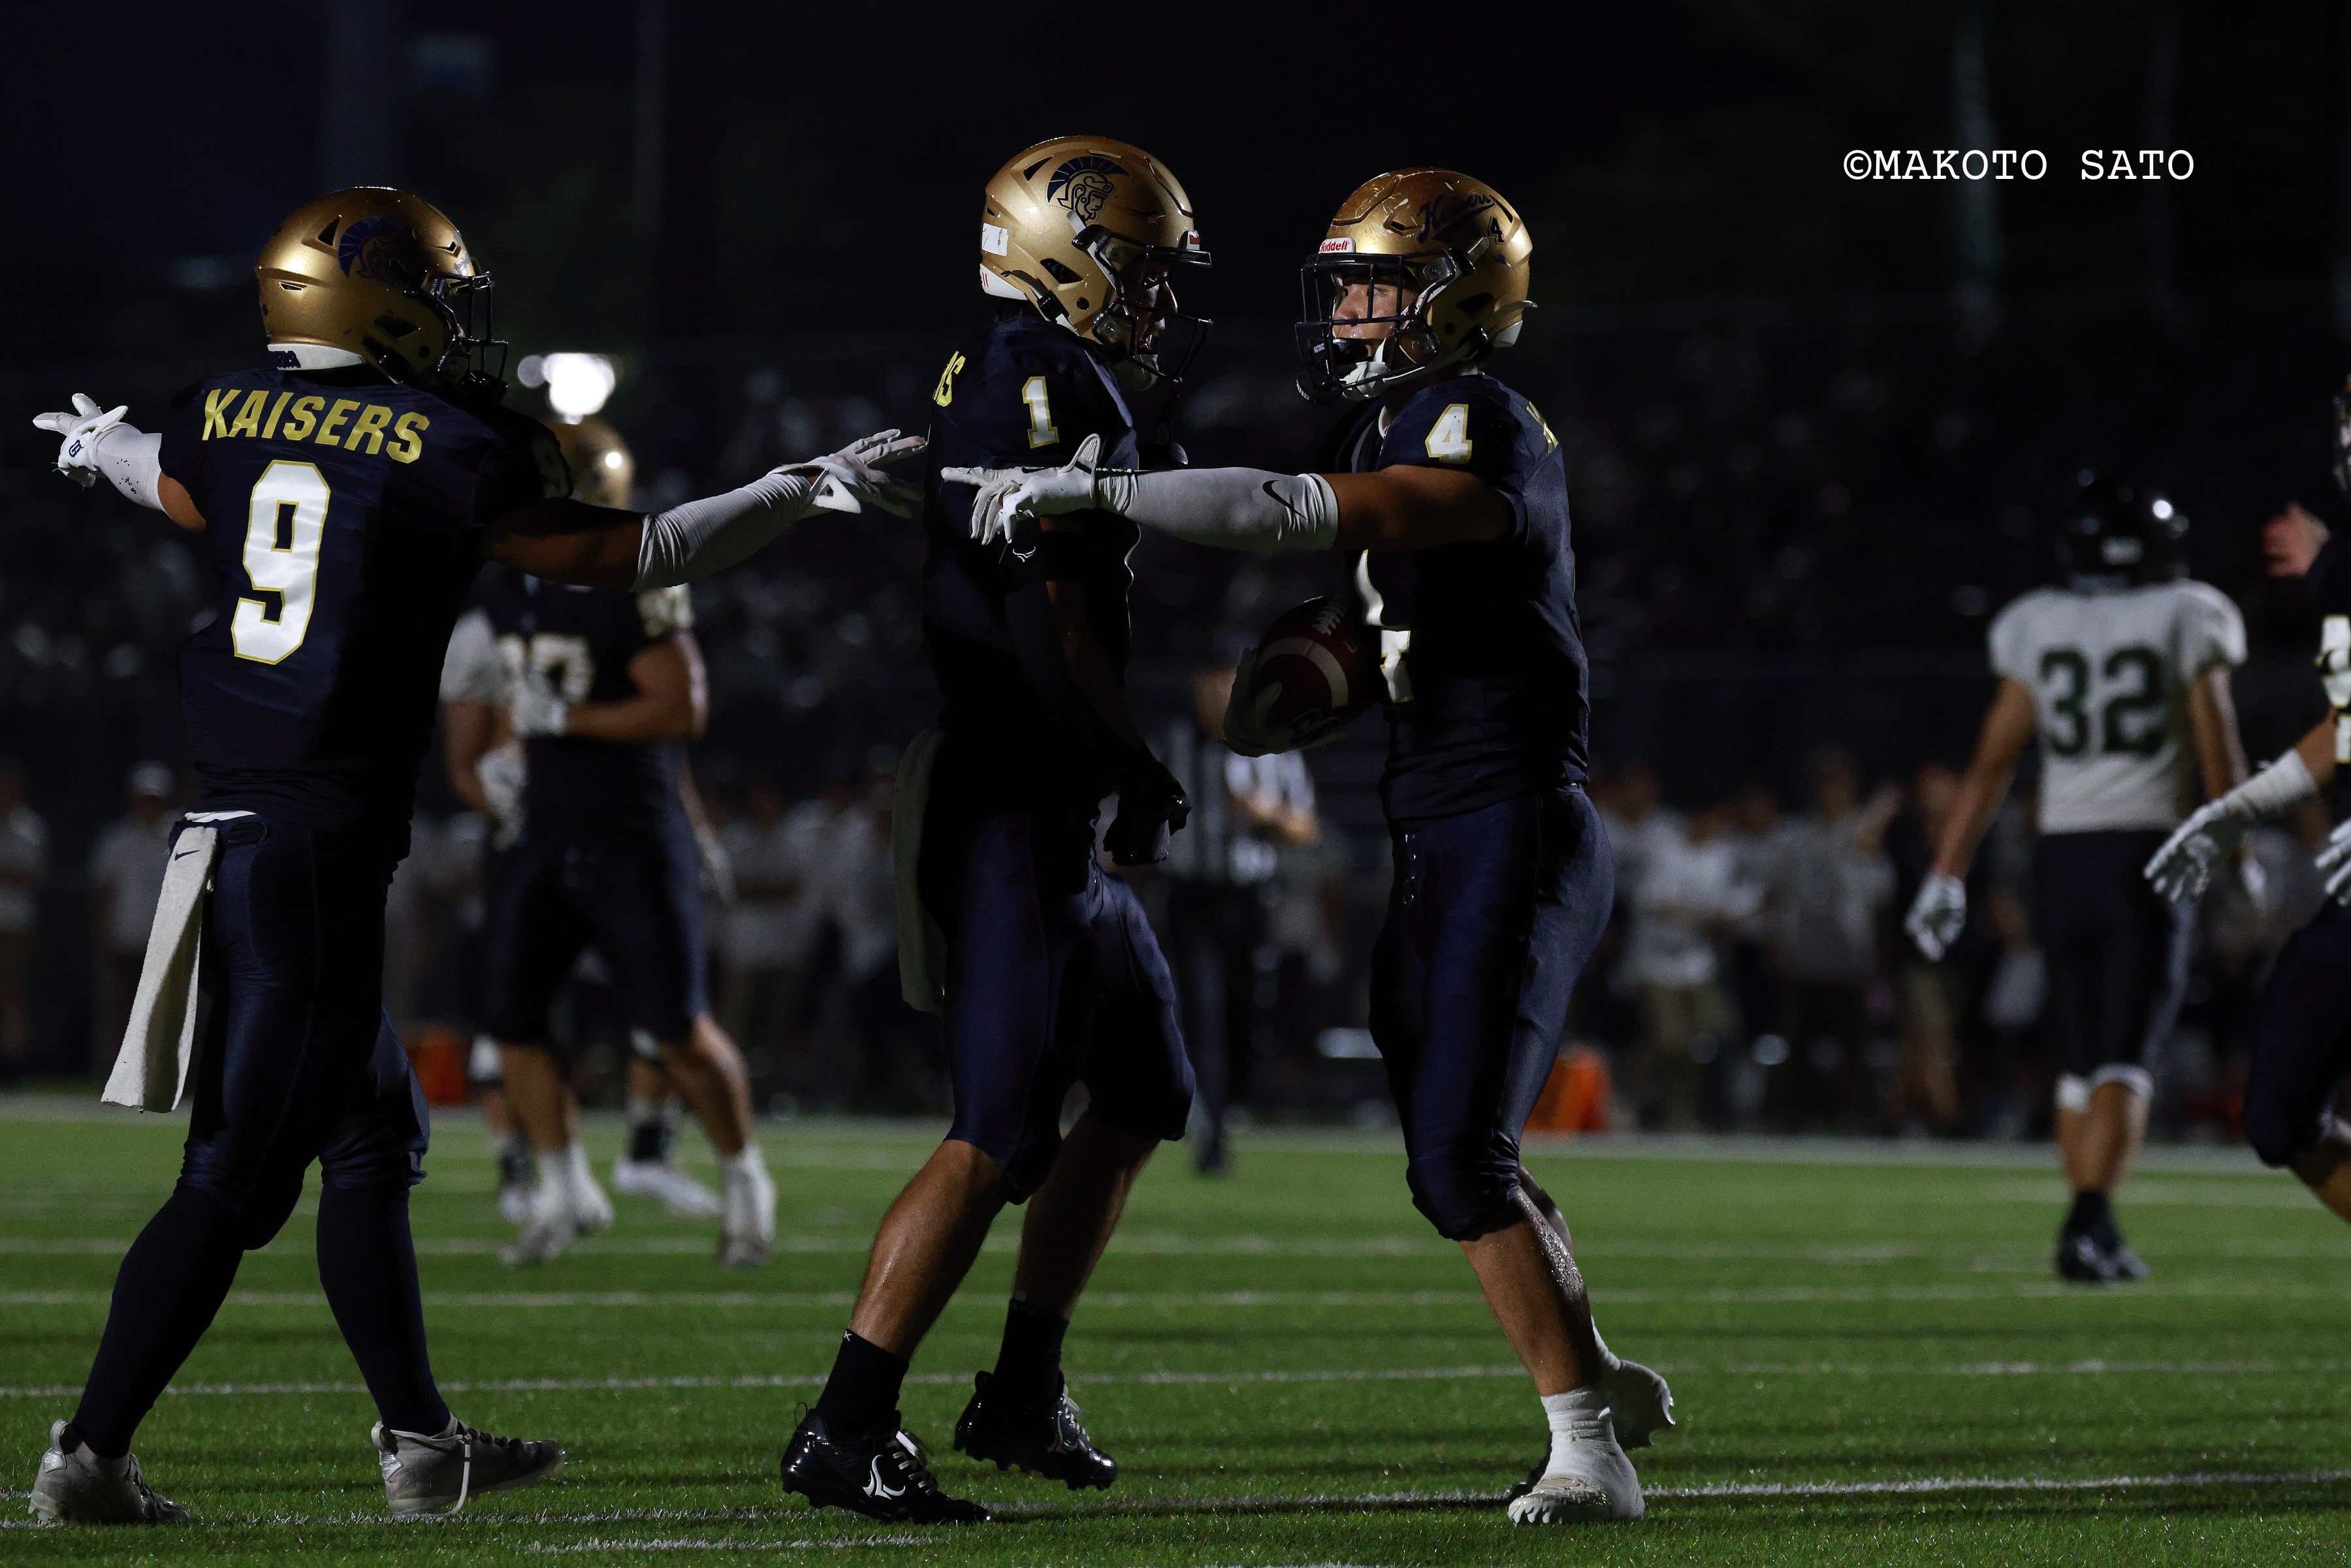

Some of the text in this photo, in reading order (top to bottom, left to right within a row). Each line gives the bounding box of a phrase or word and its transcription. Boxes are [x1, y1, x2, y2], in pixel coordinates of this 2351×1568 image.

[1488, 216, 1504, 244] 4
[202, 388, 430, 464] KAISERS
[1021, 376, 1060, 449] 1
[1425, 403, 1473, 464] 4
[230, 460, 331, 665] 9
[2040, 645, 2164, 756] 32
